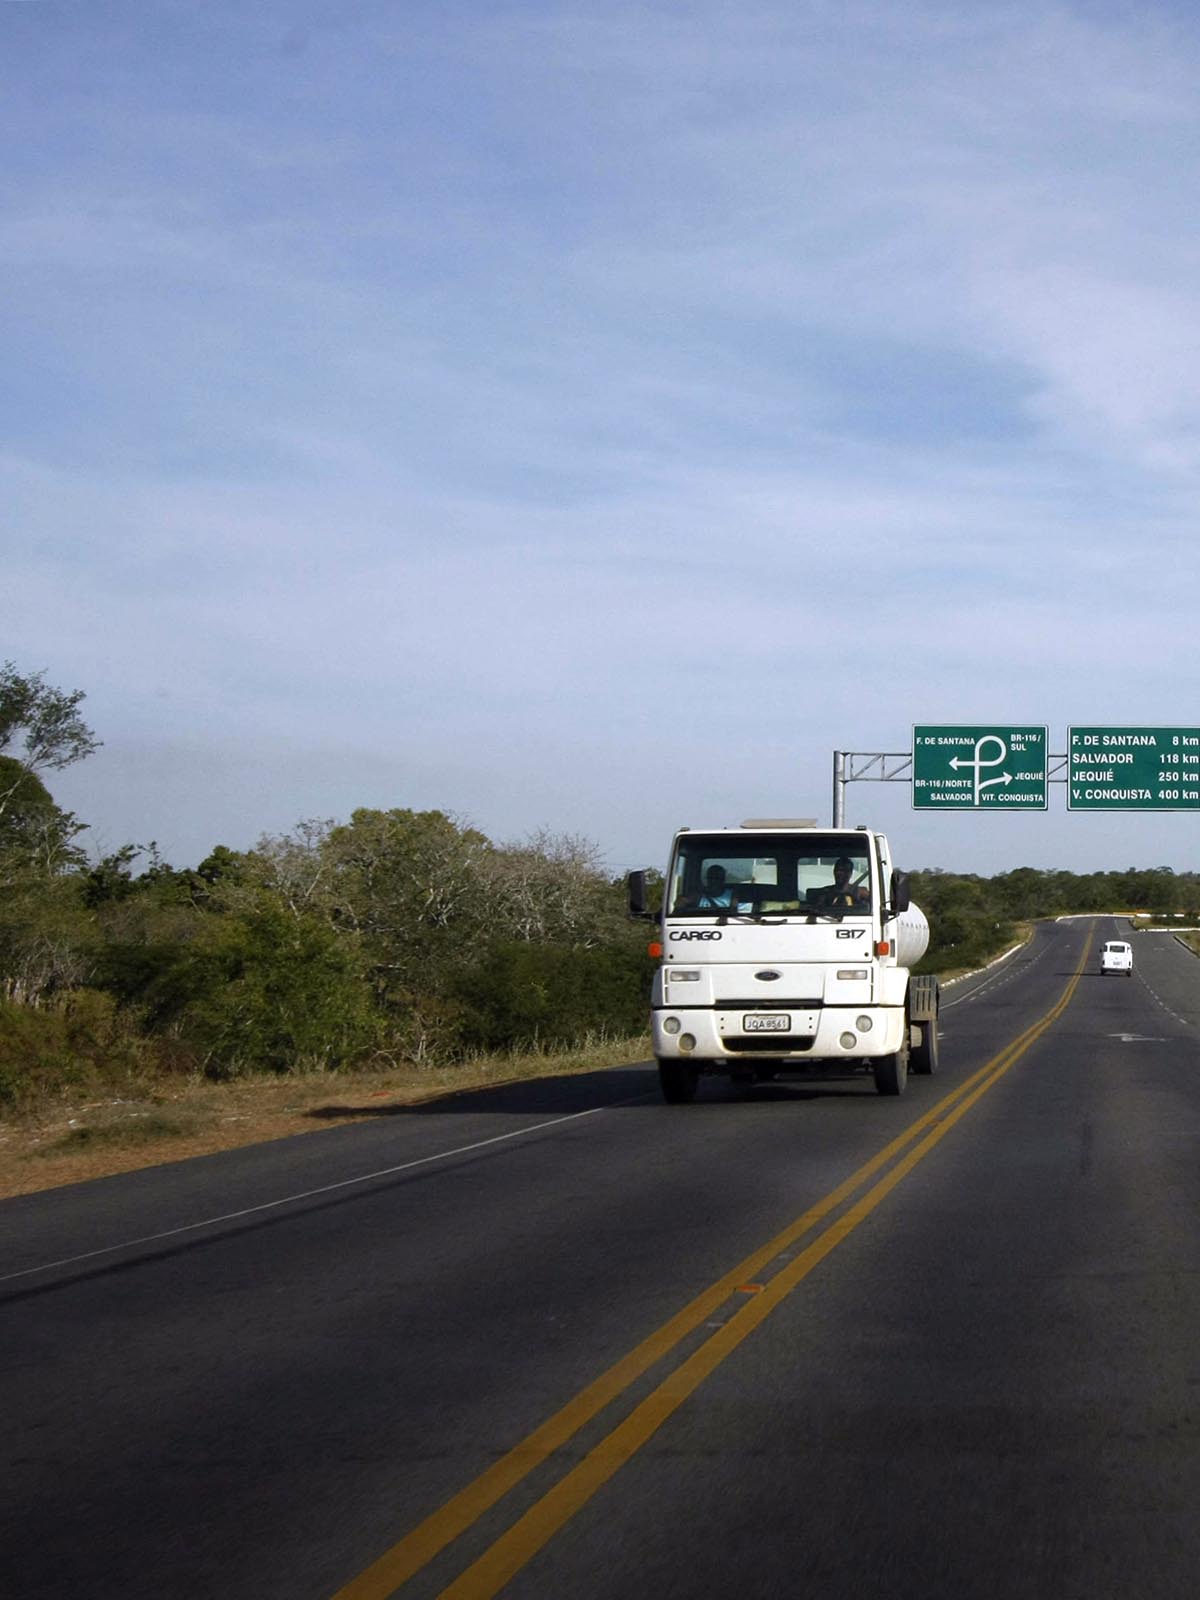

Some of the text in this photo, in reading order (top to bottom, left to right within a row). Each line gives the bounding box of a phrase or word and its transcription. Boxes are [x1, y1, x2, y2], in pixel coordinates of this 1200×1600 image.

[916, 737, 975, 745] F. DE SANTANA
[1072, 735, 1199, 746] F. DE SANTANA 8 km
[1010, 743, 1027, 751] SUL
[1072, 753, 1199, 764] SALVADOR 118 km
[1072, 768, 1199, 781] JEQUIÉ 250 km
[930, 793, 972, 801] SALVADOR
[981, 793, 1044, 802] VIT. CONQUISTA
[1072, 789, 1199, 800] V. CONQUISTA 400 km
[669, 930, 722, 941] CARGO
